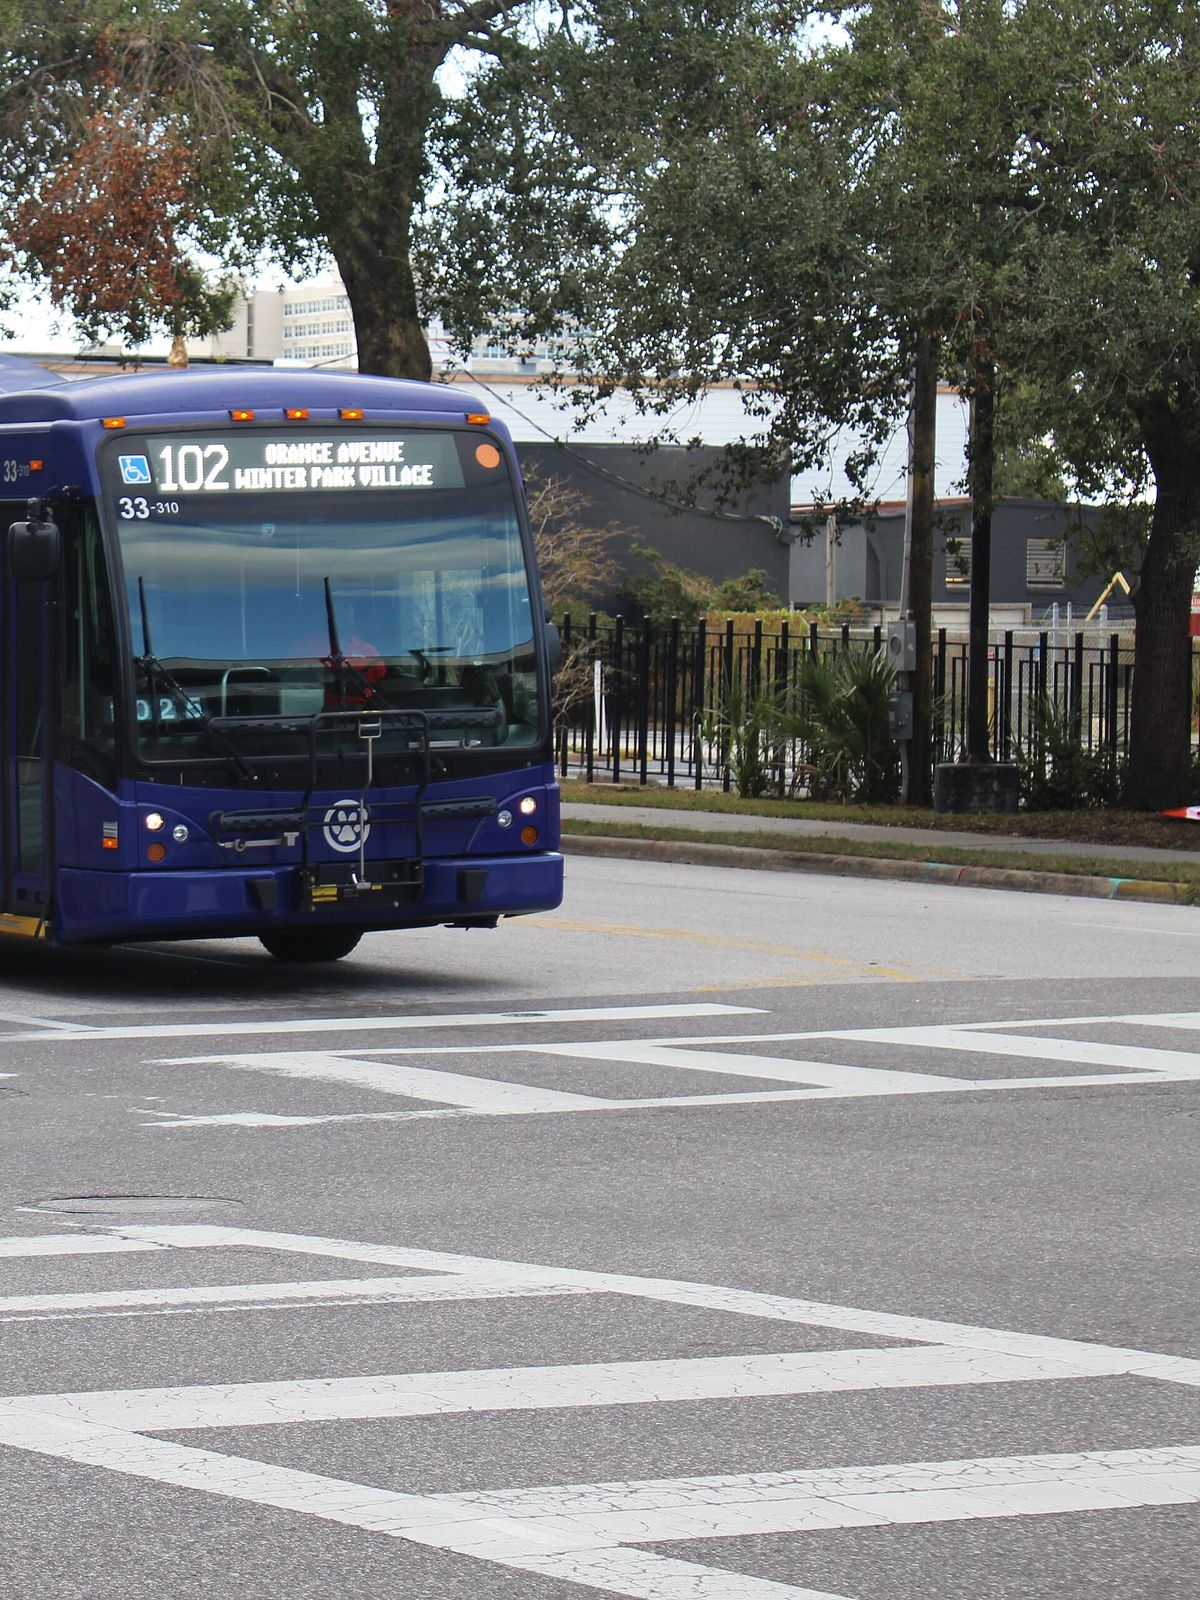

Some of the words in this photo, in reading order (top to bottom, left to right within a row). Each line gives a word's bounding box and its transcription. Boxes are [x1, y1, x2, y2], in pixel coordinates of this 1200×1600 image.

[265, 442, 334, 465] ORANGE
[337, 441, 405, 463] AVENUE
[159, 444, 230, 491] 102
[234, 466, 307, 489] WINTER
[310, 466, 355, 488] PARK
[358, 464, 434, 487] VILLAGE
